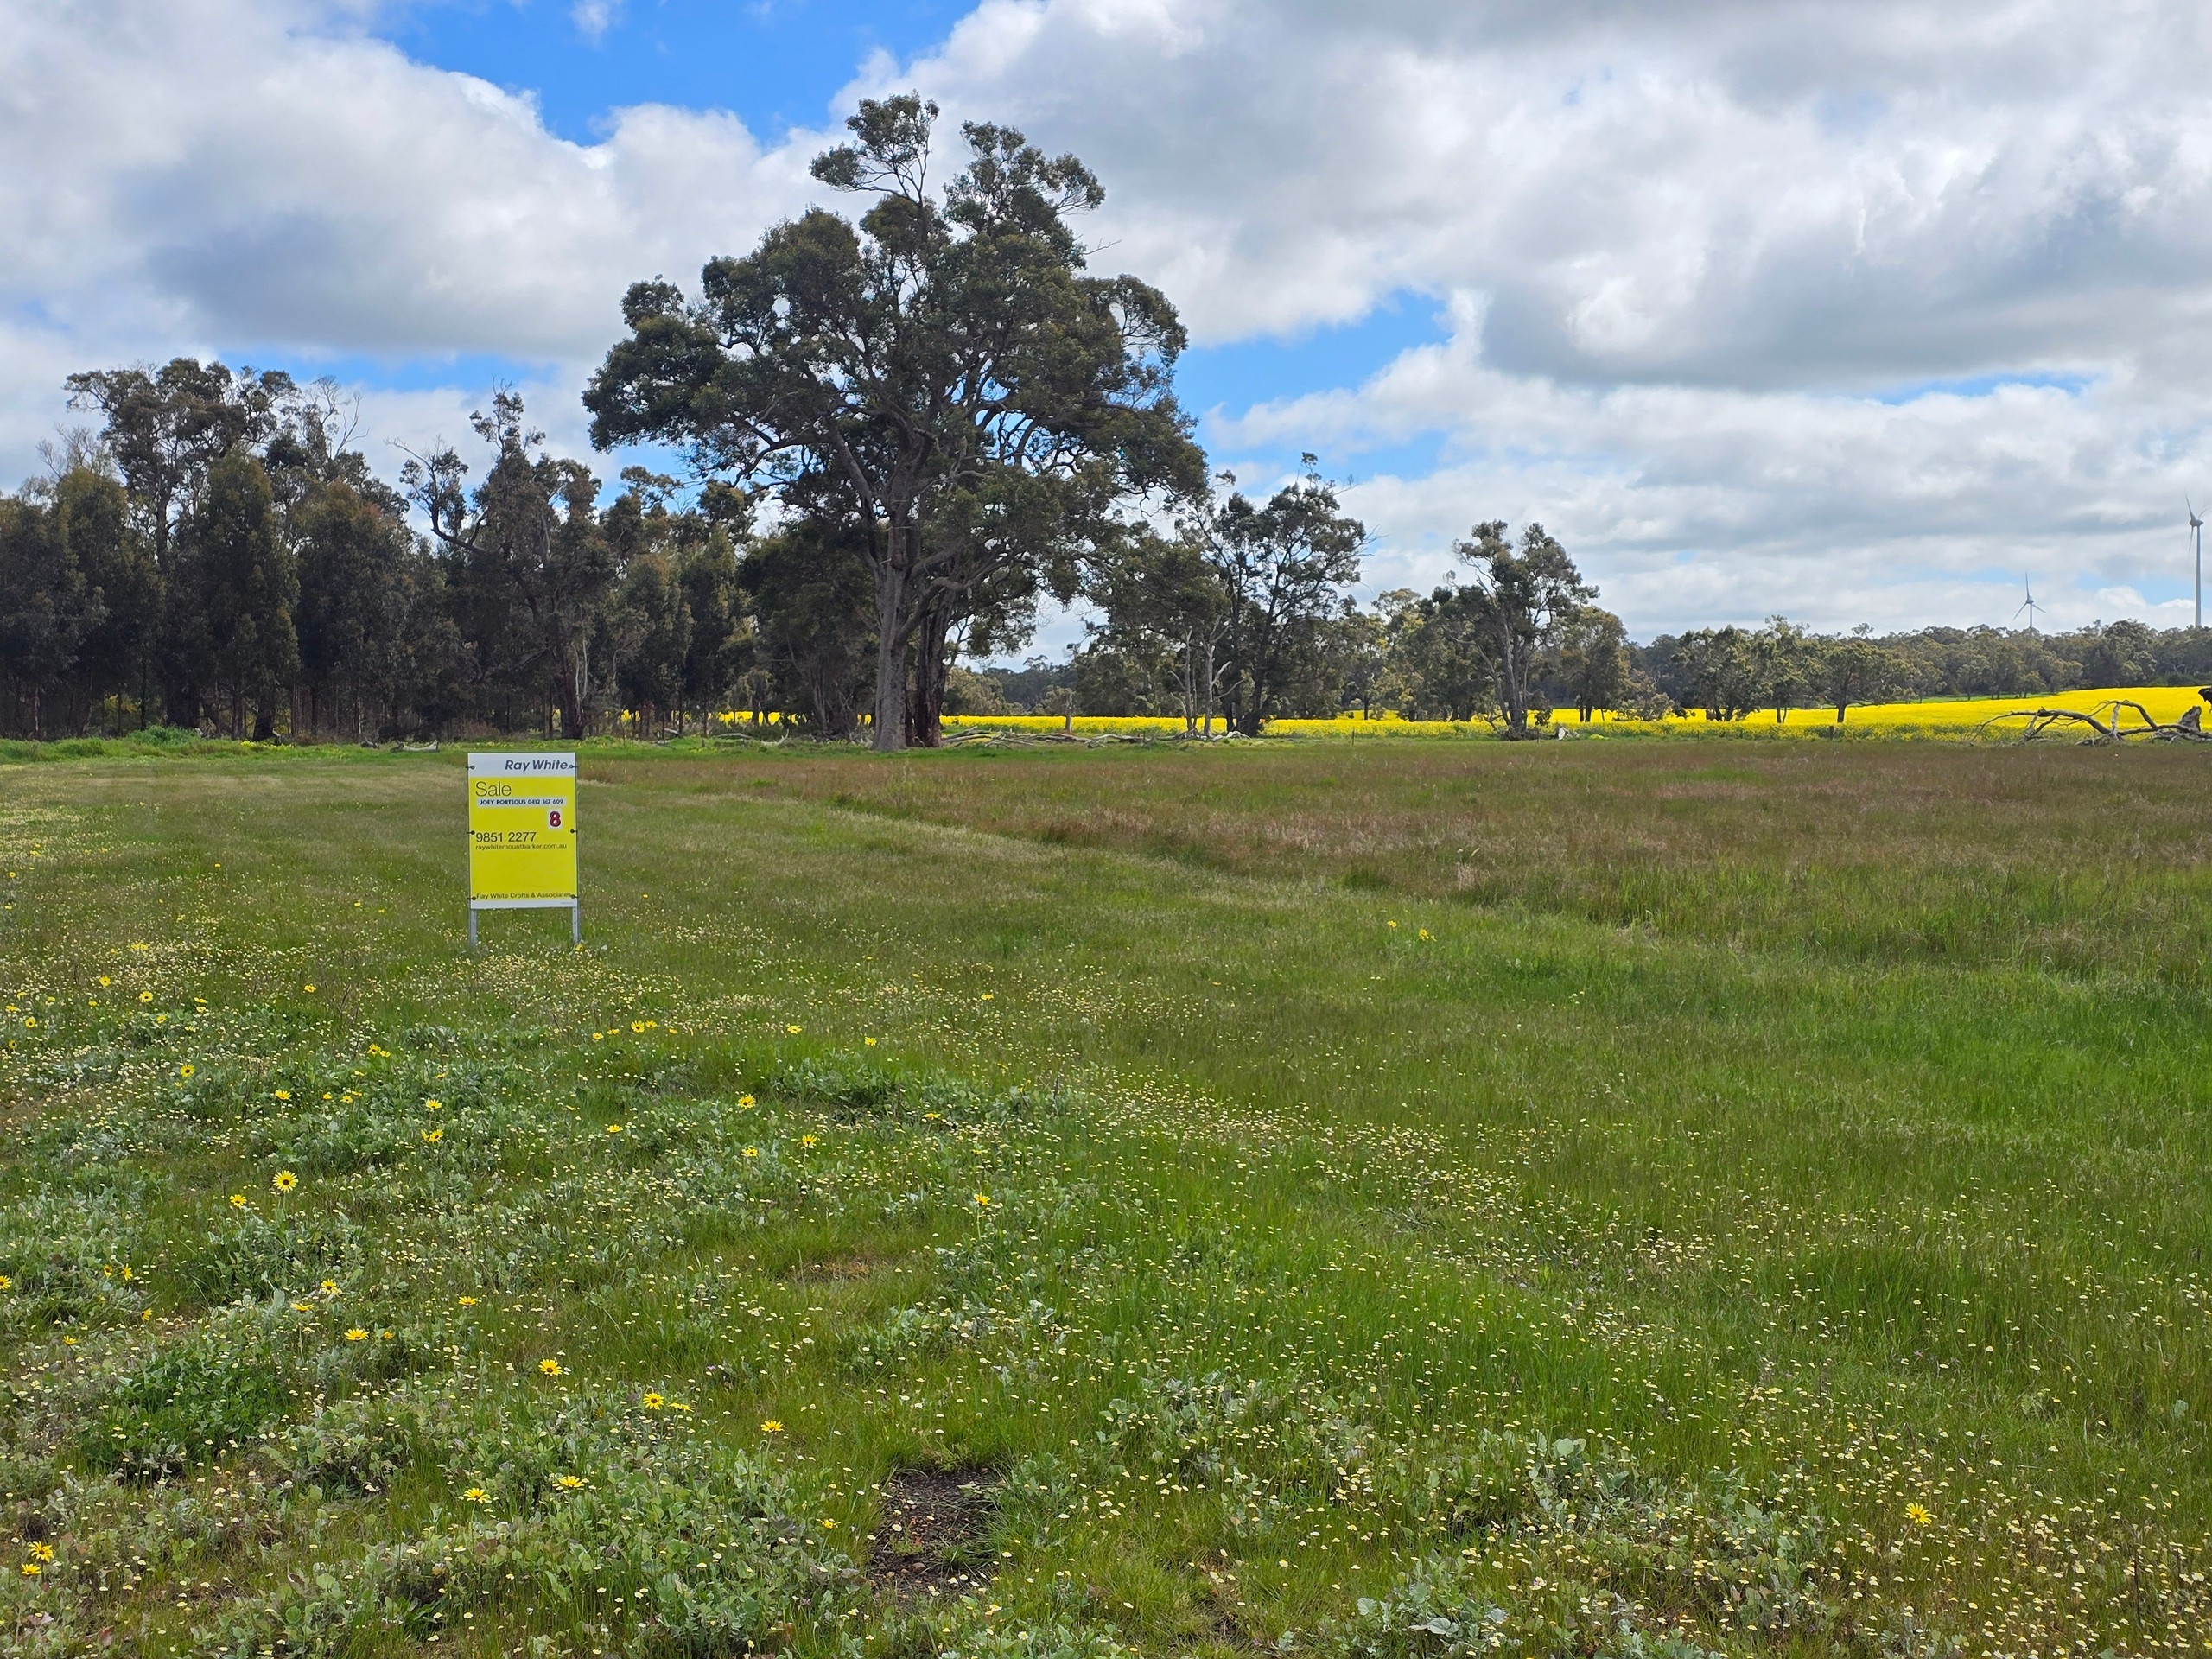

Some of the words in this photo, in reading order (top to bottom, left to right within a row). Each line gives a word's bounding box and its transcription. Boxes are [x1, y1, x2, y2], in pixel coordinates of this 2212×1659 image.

[505, 760, 530, 772] Ray
[475, 781, 512, 797] Sale
[549, 810, 561, 827] 8
[475, 832, 503, 842] 9851
[508, 831, 537, 842] 2277
